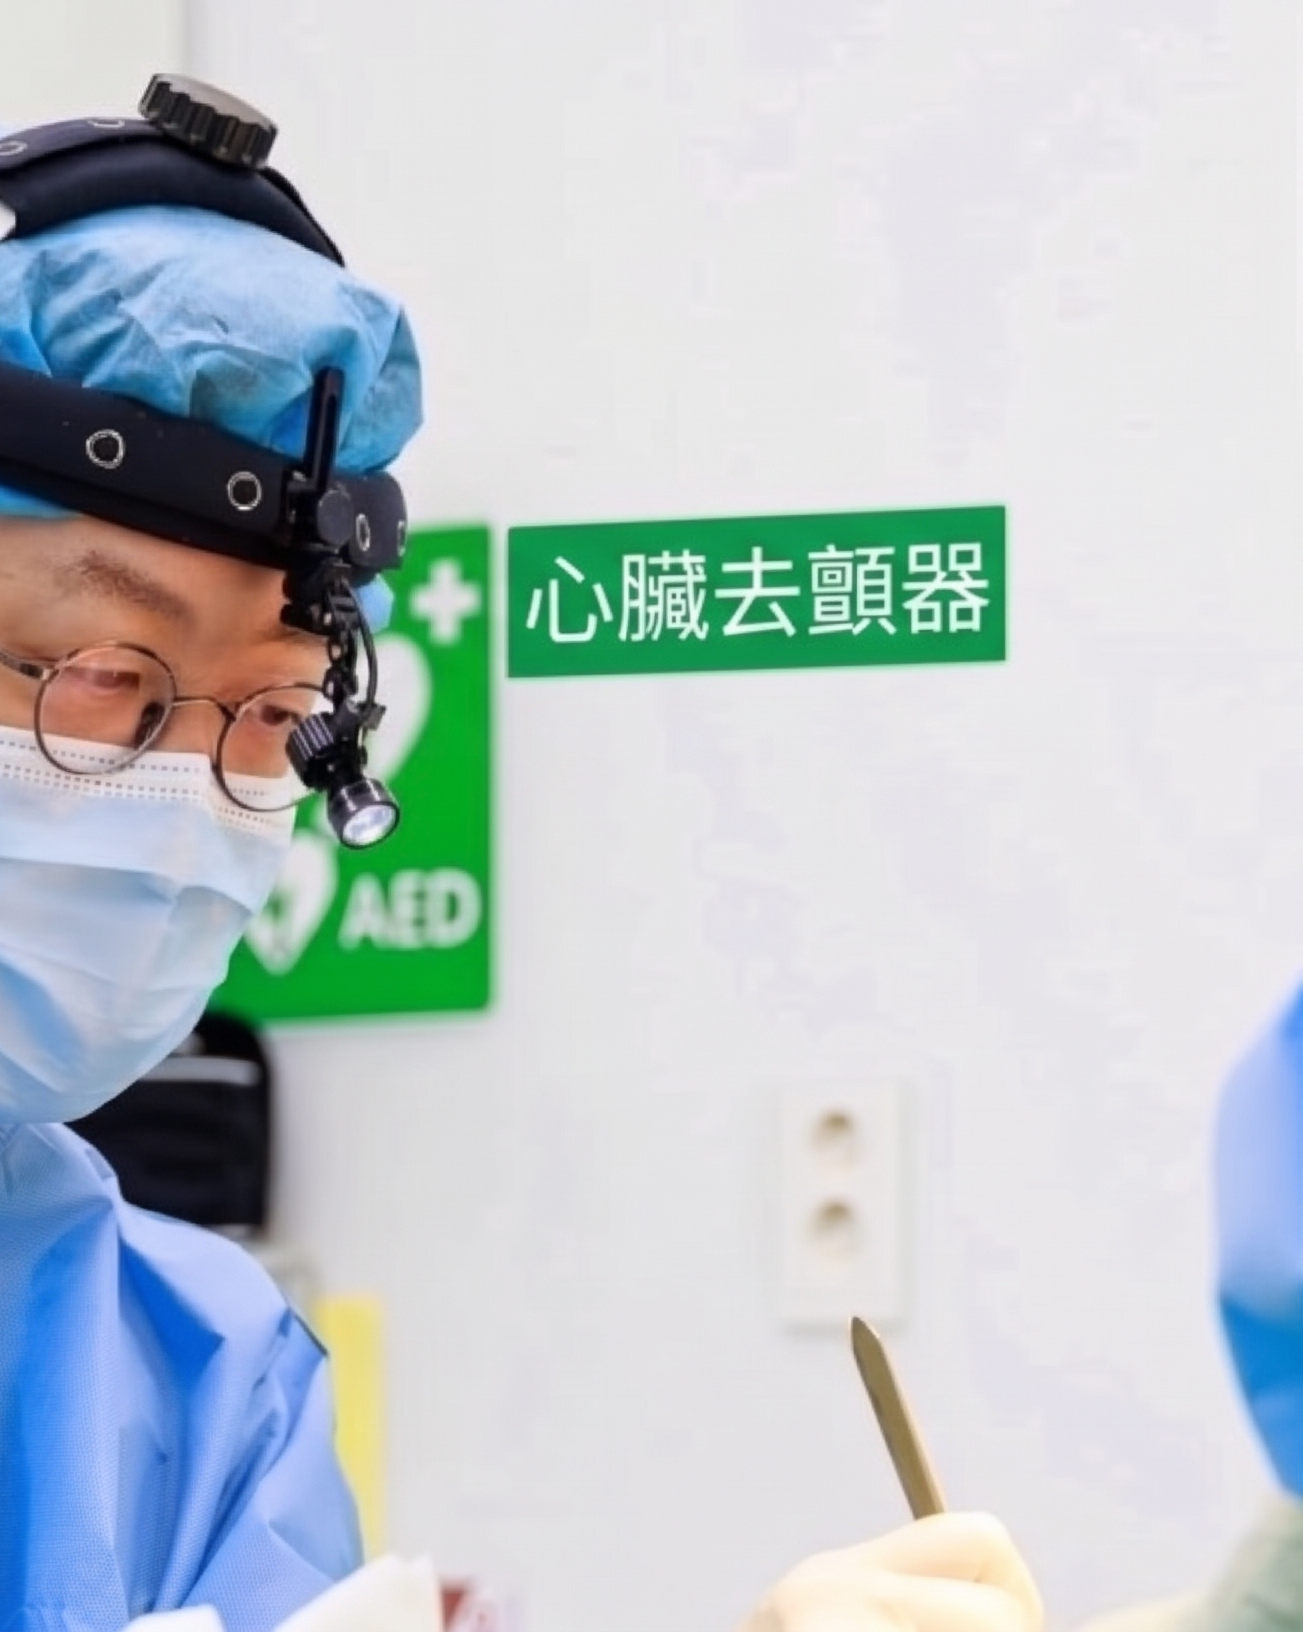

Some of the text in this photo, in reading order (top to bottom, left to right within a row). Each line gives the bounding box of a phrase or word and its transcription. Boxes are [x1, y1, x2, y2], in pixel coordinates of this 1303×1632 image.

[526, 542, 989, 643] 心臟去顫器
[340, 870, 481, 948] AED
